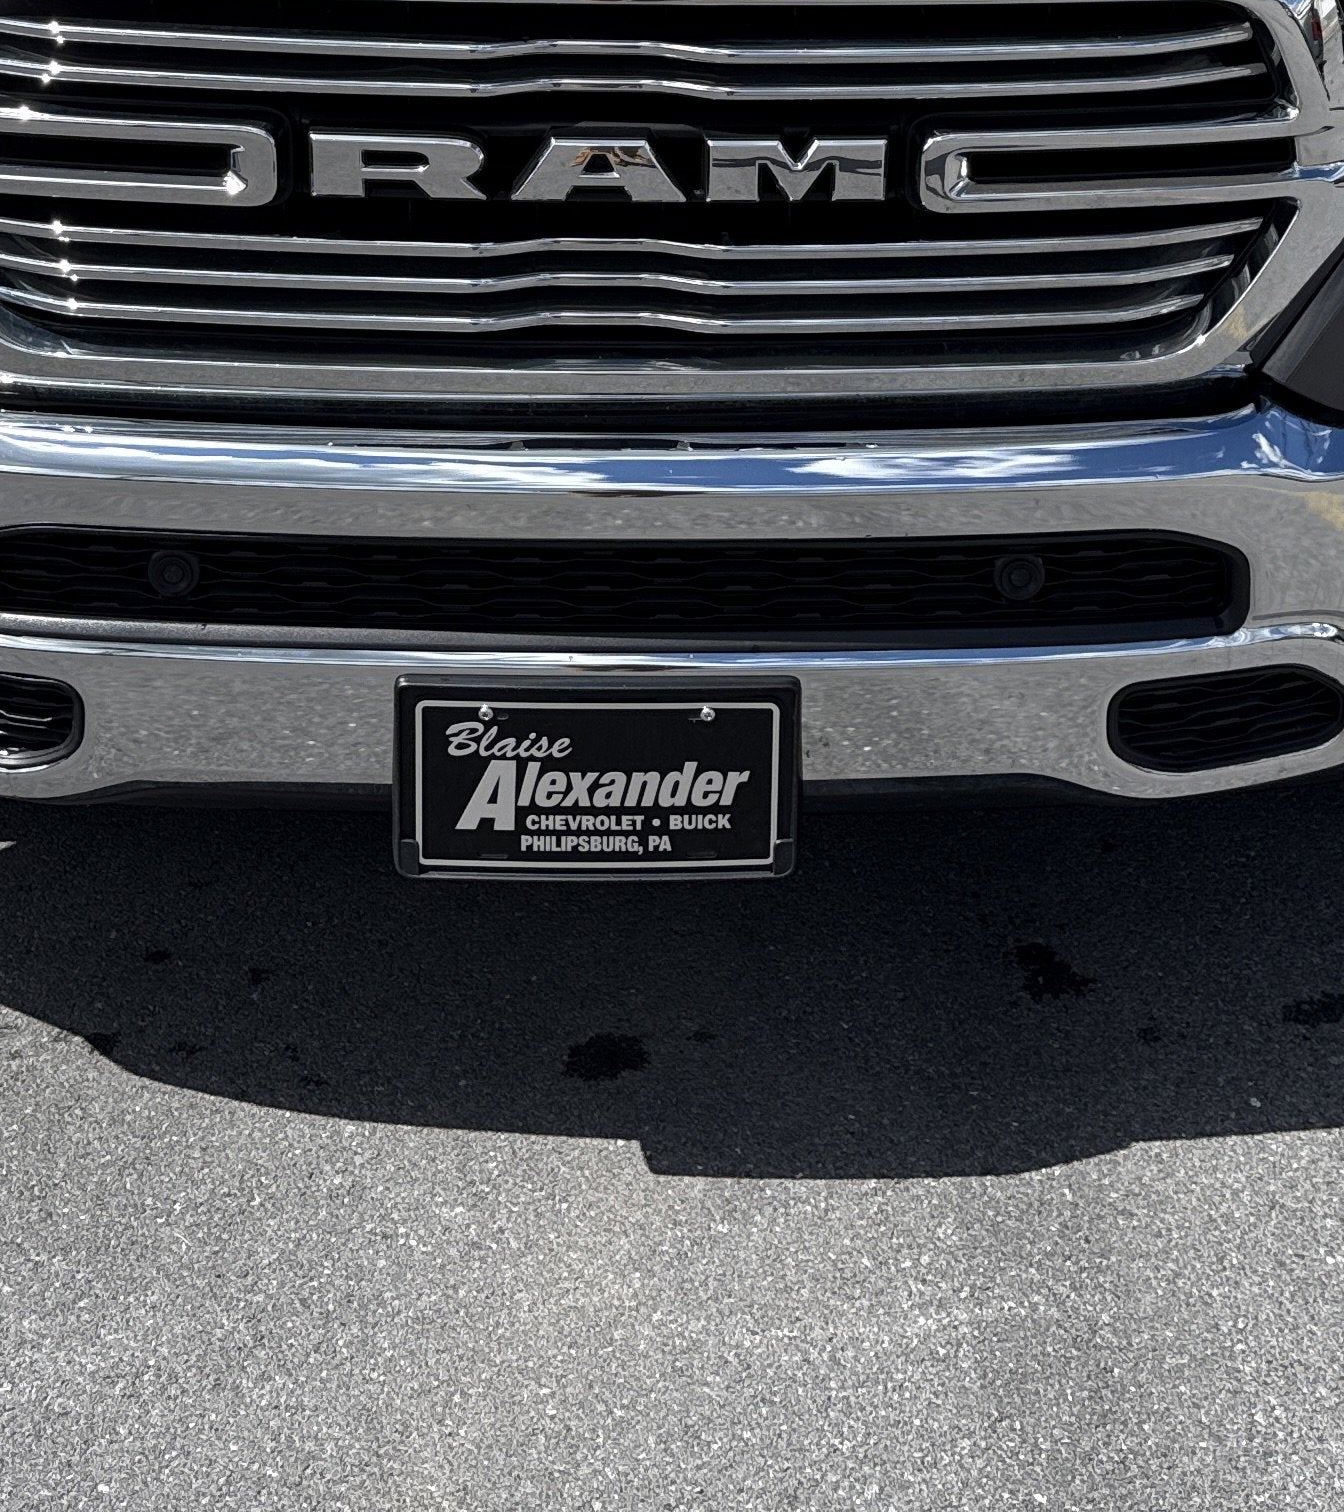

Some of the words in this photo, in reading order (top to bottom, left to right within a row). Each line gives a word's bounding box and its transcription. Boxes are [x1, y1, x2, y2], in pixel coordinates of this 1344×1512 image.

[309, 130, 888, 202] RAM
[445, 721, 573, 758] Blaise
[455, 759, 751, 830] Alexander
[525, 814, 645, 831] CHEVROLET
[668, 813, 732, 830] BUICK
[520, 834, 644, 855] PHILIPSBURG,
[648, 834, 672, 853] PA
